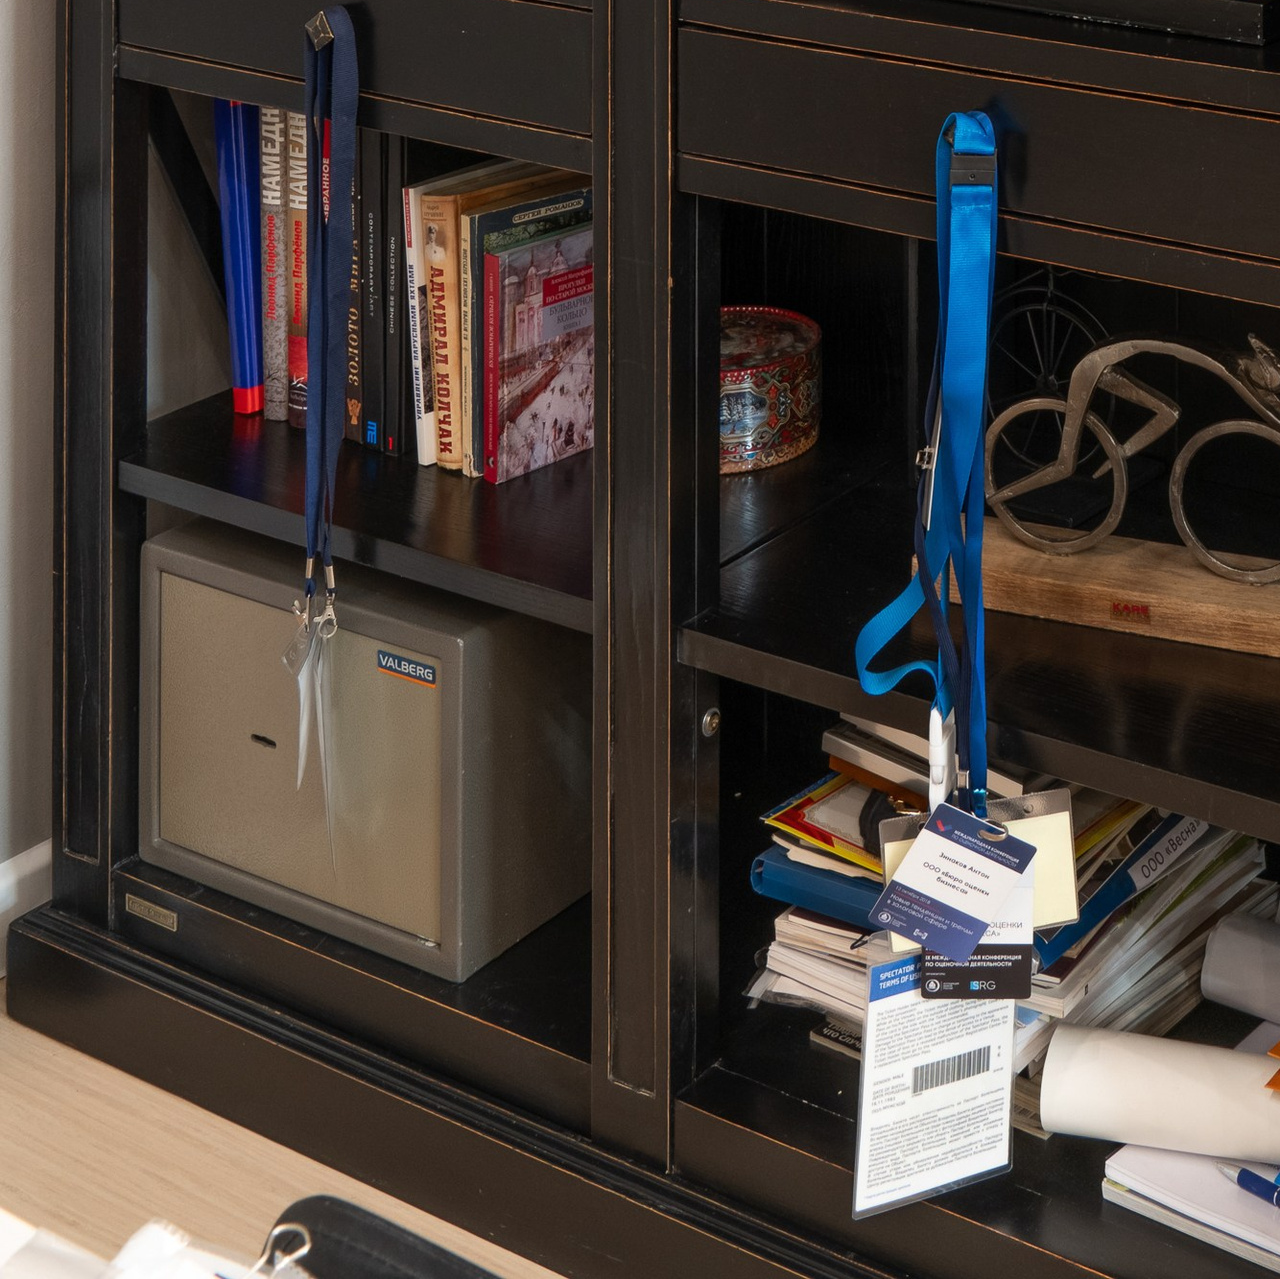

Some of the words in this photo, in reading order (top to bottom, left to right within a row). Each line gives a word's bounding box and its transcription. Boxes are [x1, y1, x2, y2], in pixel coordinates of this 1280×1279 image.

[266, 214, 276, 272] Парфёнов
[266, 277, 276, 319] Леонид
[408, 263, 416, 299] ЯХТАМИ
[411, 305, 419, 360] ПАРУСНЫМИ
[429, 264, 450, 366] АДМИРАЛ
[433, 371, 456, 454] КОЛЧАК
[379, 653, 433, 681] VALBERG
[923, 860, 941, 874] ООО
[939, 868, 963, 885] «Бюро
[964, 882, 989, 896] оценки
[968, 867, 989, 879] Антон
[1141, 851, 1166, 881] ООО
[936, 877, 968, 894] бизнеса»
[879, 964, 915, 980] SPECTATOR
